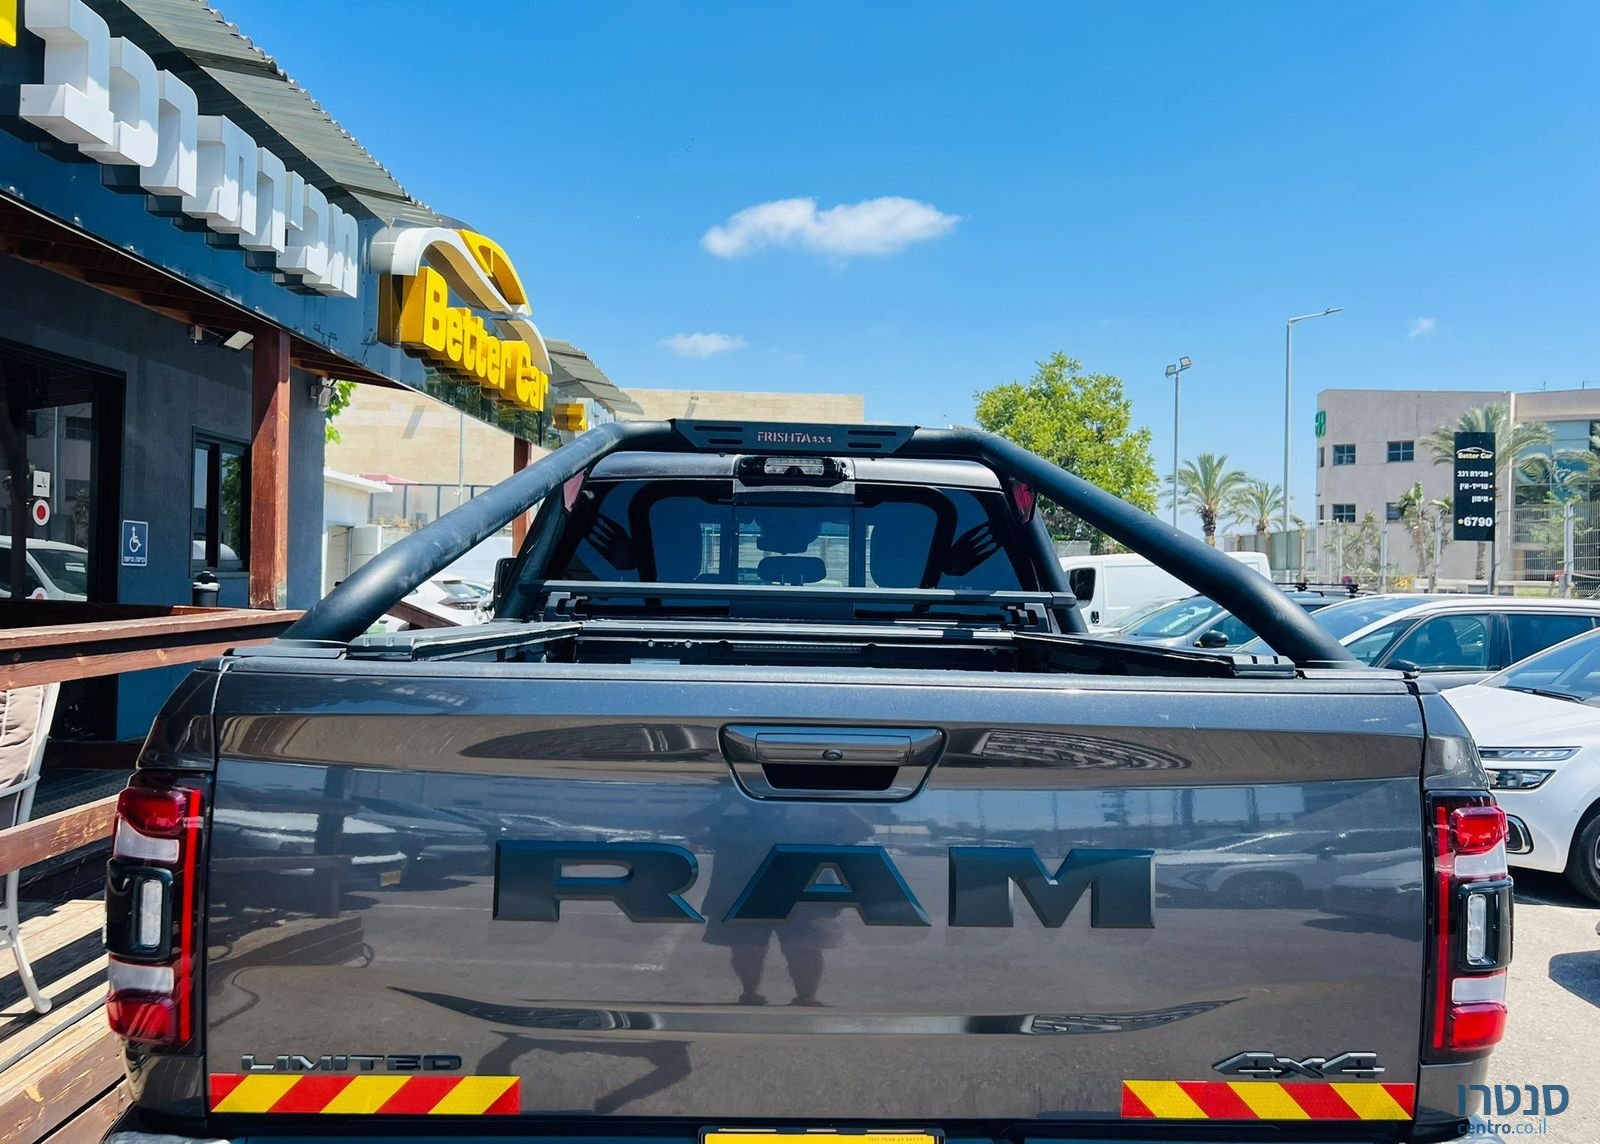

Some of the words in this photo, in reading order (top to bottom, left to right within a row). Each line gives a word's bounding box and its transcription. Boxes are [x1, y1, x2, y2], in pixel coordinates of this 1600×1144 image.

[20, 0, 199, 198] רכב
[184, 114, 359, 299] מכירת
[416, 265, 512, 391] Better
[514, 339, 550, 413] Car
[492, 839, 1157, 929] RAM
[240, 1053, 463, 1073] LIMITED
